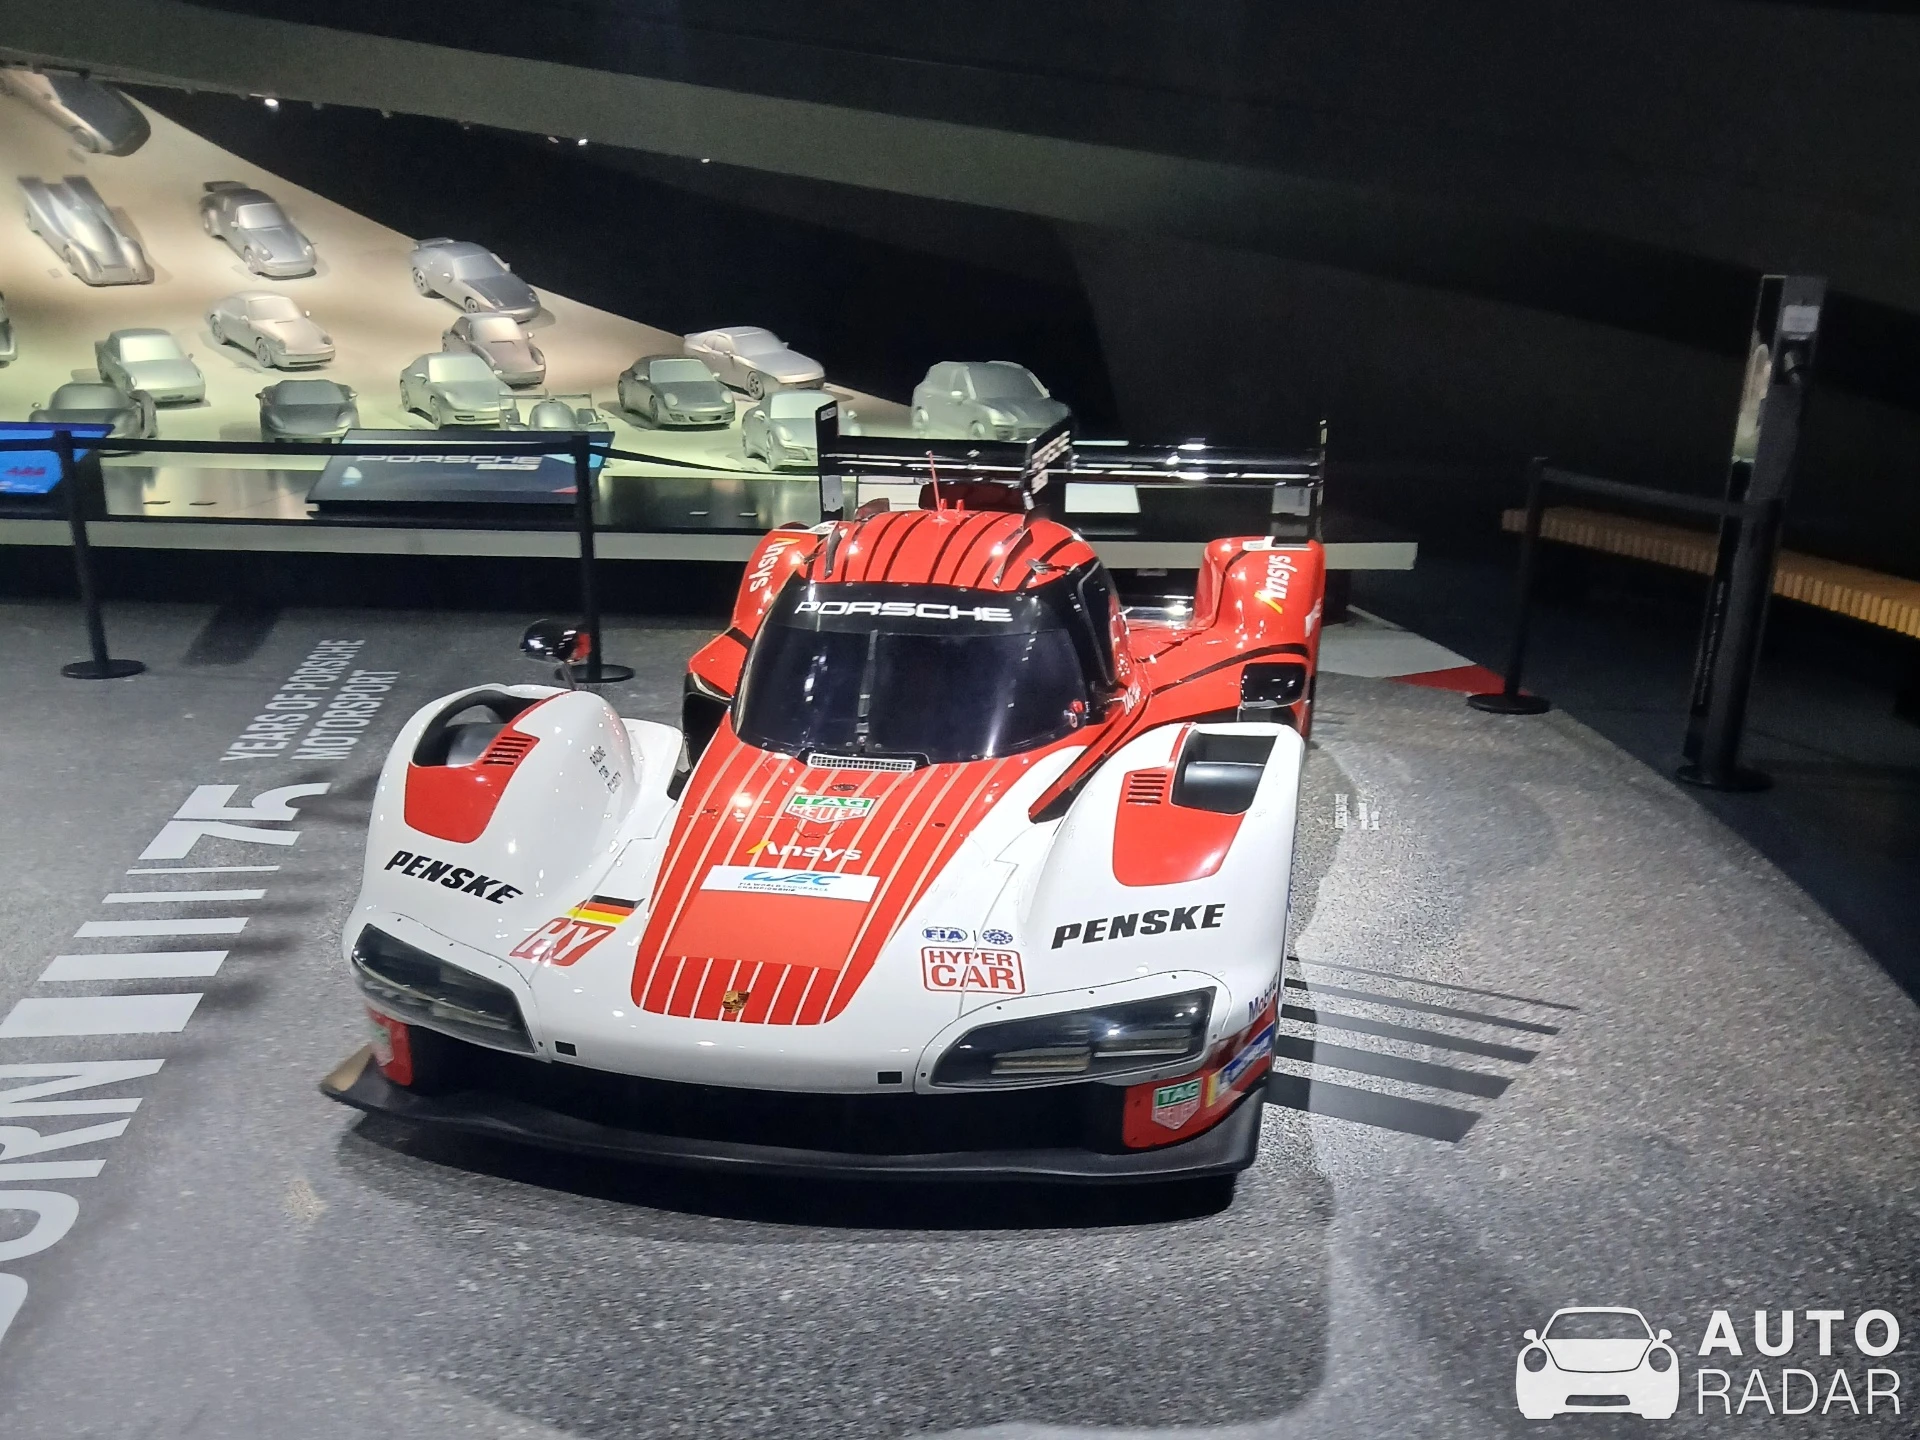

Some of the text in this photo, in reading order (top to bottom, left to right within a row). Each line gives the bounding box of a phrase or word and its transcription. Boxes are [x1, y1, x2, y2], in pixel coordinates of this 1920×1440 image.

[357, 455, 543, 464] PORSCHE
[749, 537, 801, 593] Ansys
[1254, 554, 1298, 615] Ansys
[795, 601, 1014, 622] PORSCHE
[220, 640, 365, 761] YEARS OF PORSCHE
[291, 670, 400, 760] MOTORSPORT
[790, 806, 866, 820] HEUER
[800, 797, 866, 807] TAG
[138, 782, 332, 860] 75
[746, 840, 863, 862] Ansys
[384, 850, 524, 904] PENSKE
[743, 872, 842, 886] WEC
[1051, 903, 1226, 950] PENSKE
[928, 950, 1014, 967] HYPER
[931, 964, 1017, 990] CAR
[1160, 1081, 1199, 1104] TAG
